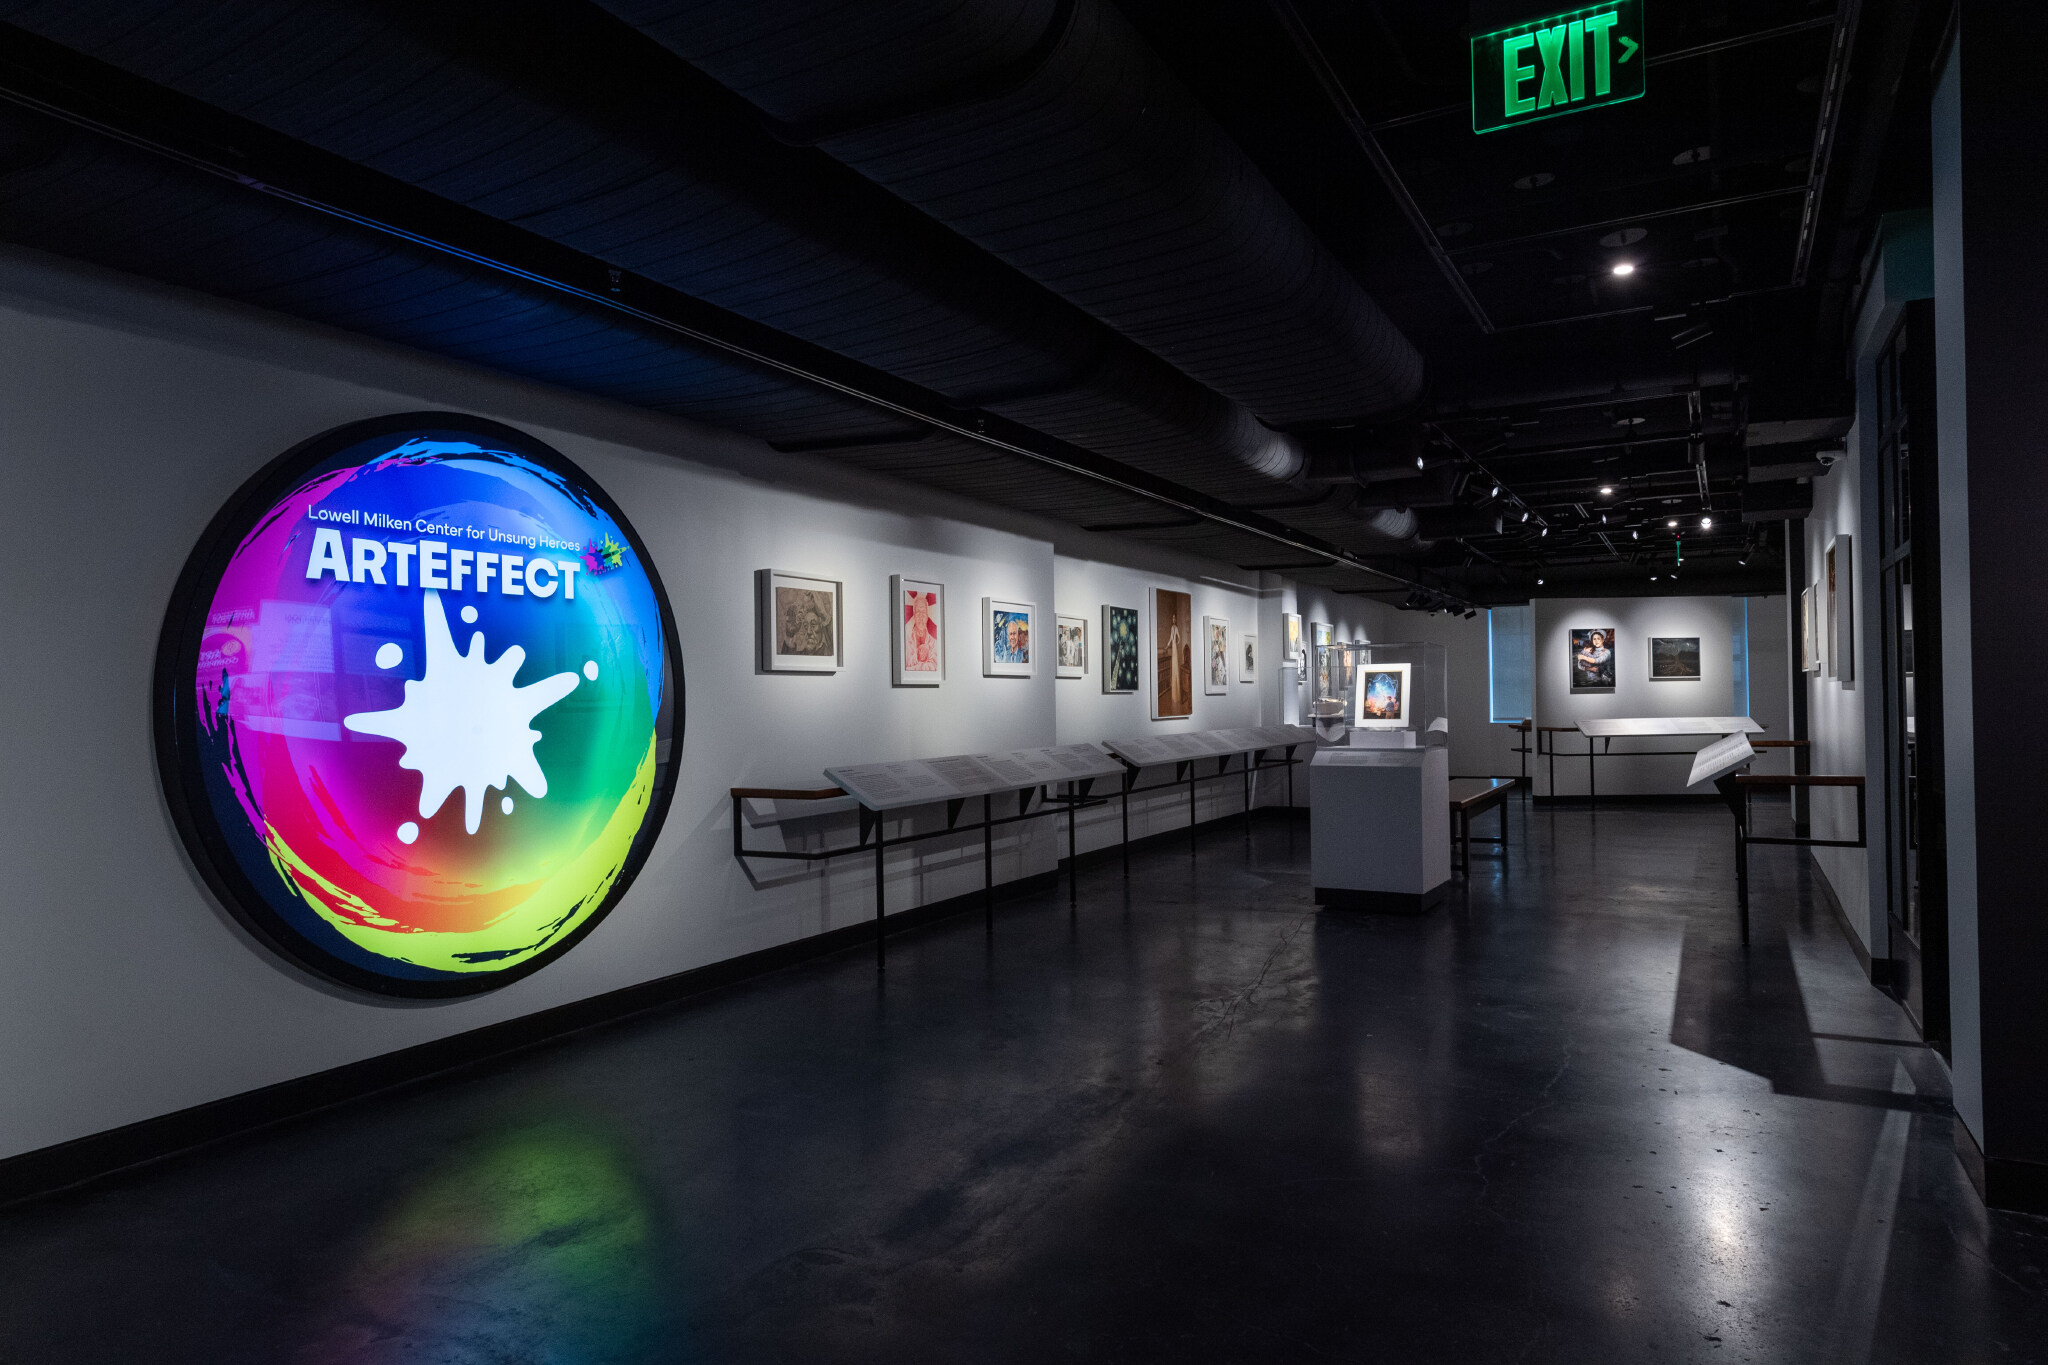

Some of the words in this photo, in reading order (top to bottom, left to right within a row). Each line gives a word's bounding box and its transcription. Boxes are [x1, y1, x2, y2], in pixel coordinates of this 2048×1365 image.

[1503, 11, 1618, 117] EXIT
[306, 527, 581, 600] ARTEFFECT
[308, 504, 359, 525] Lowell
[363, 511, 412, 531] Milken
[415, 519, 464, 536] Center
[465, 525, 485, 540] for
[488, 528, 536, 549] Unsung
[539, 536, 580, 552] Heroes
